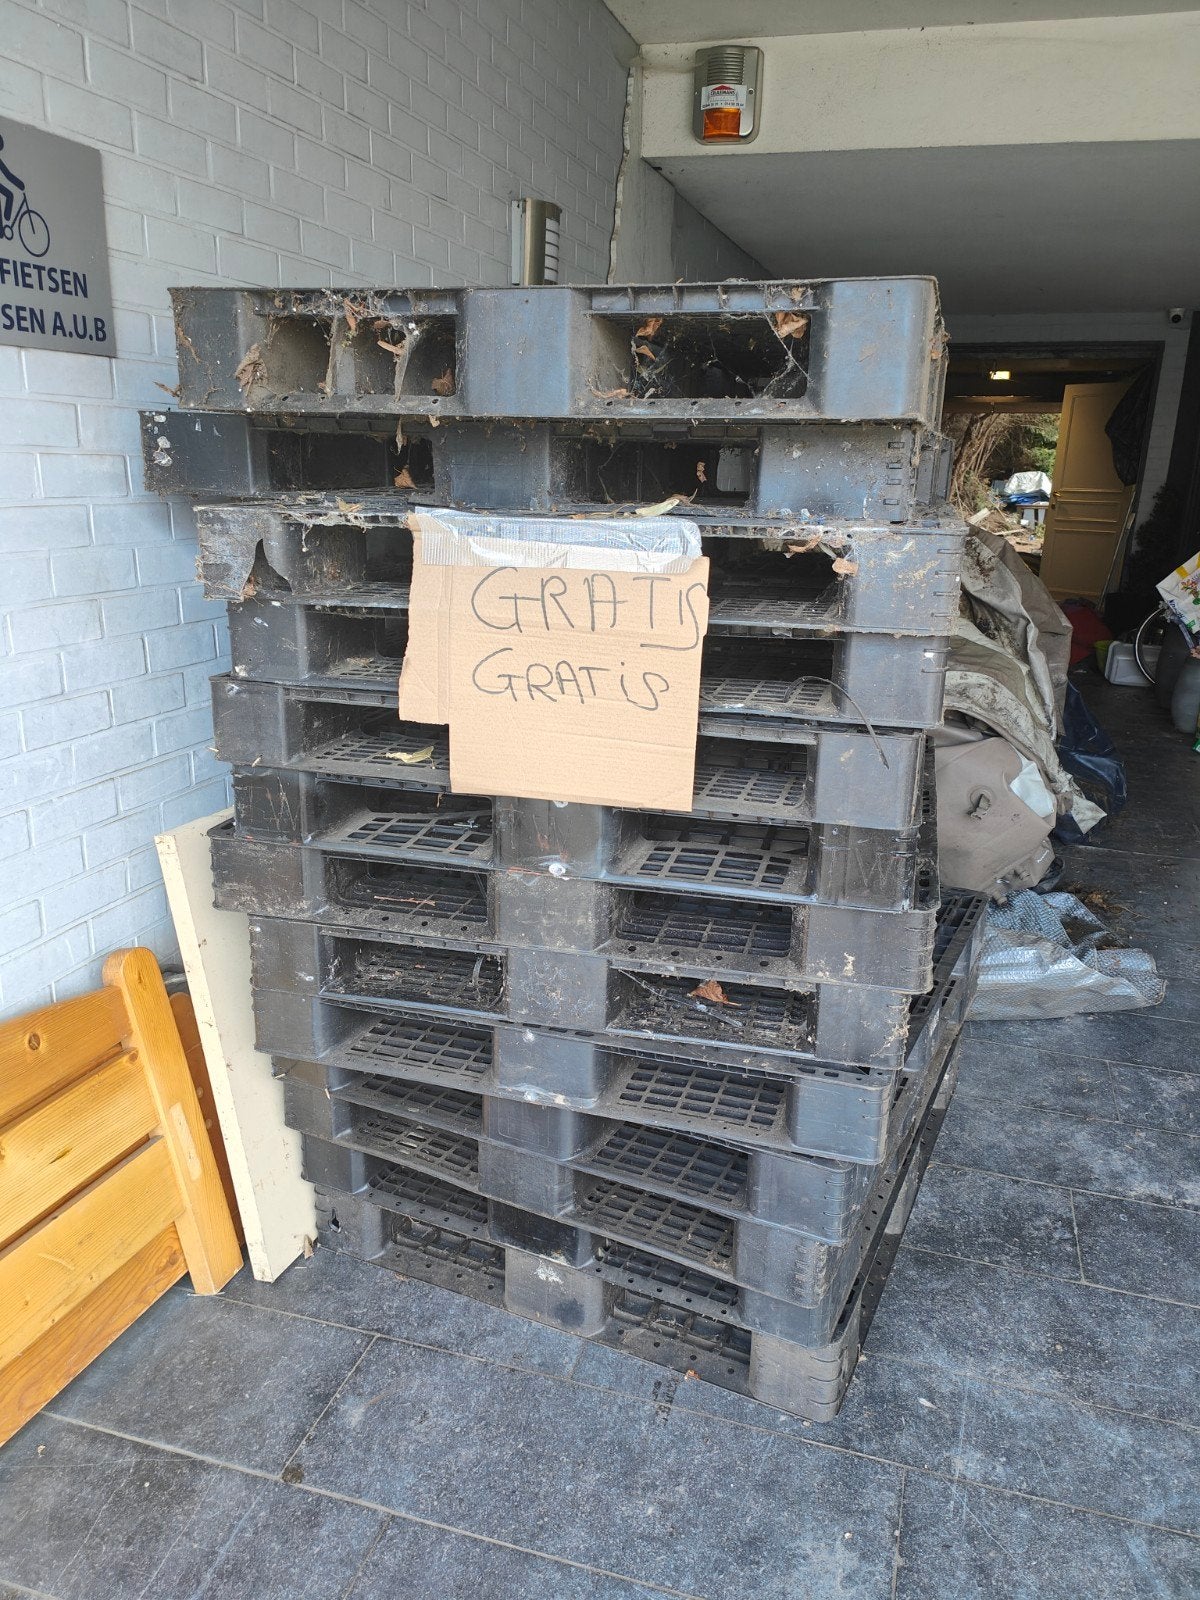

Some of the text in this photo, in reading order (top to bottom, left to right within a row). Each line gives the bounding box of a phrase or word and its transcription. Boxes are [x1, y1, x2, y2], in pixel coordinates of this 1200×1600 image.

[0, 257, 88, 299] FIETSEN
[52, 311, 107, 342] A.U.B
[471, 566, 706, 651] GRATIS
